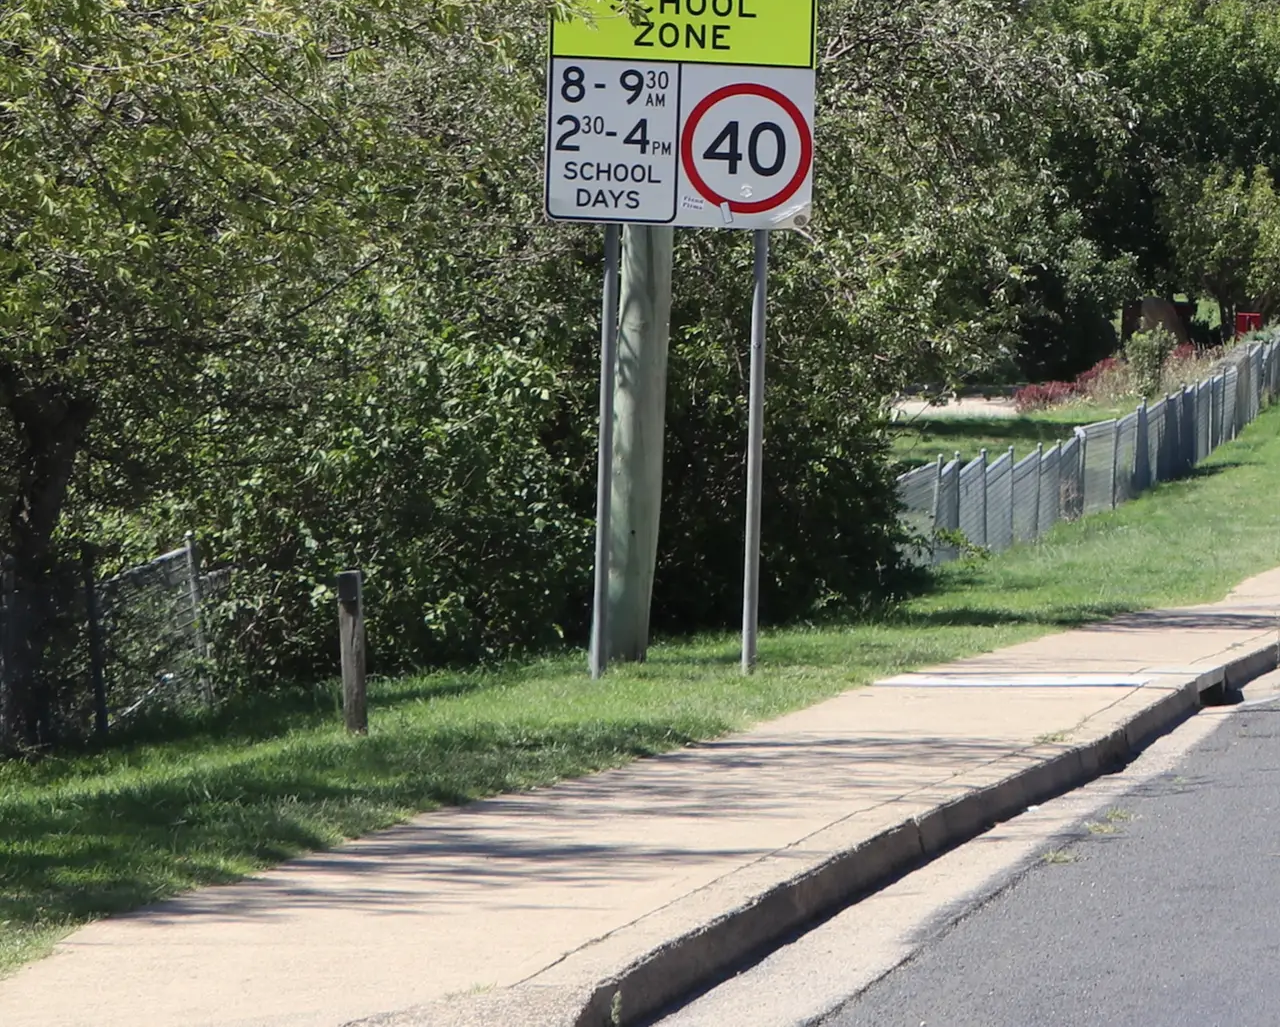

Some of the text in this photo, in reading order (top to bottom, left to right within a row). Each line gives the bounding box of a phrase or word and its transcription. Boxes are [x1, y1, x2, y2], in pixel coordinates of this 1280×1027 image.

[633, 22, 731, 50] ZONE
[645, 93, 666, 108] AM
[652, 142, 672, 156] PM
[702, 121, 786, 176] 40
[563, 161, 662, 184] SCHOOL
[576, 189, 640, 209] DAYS
